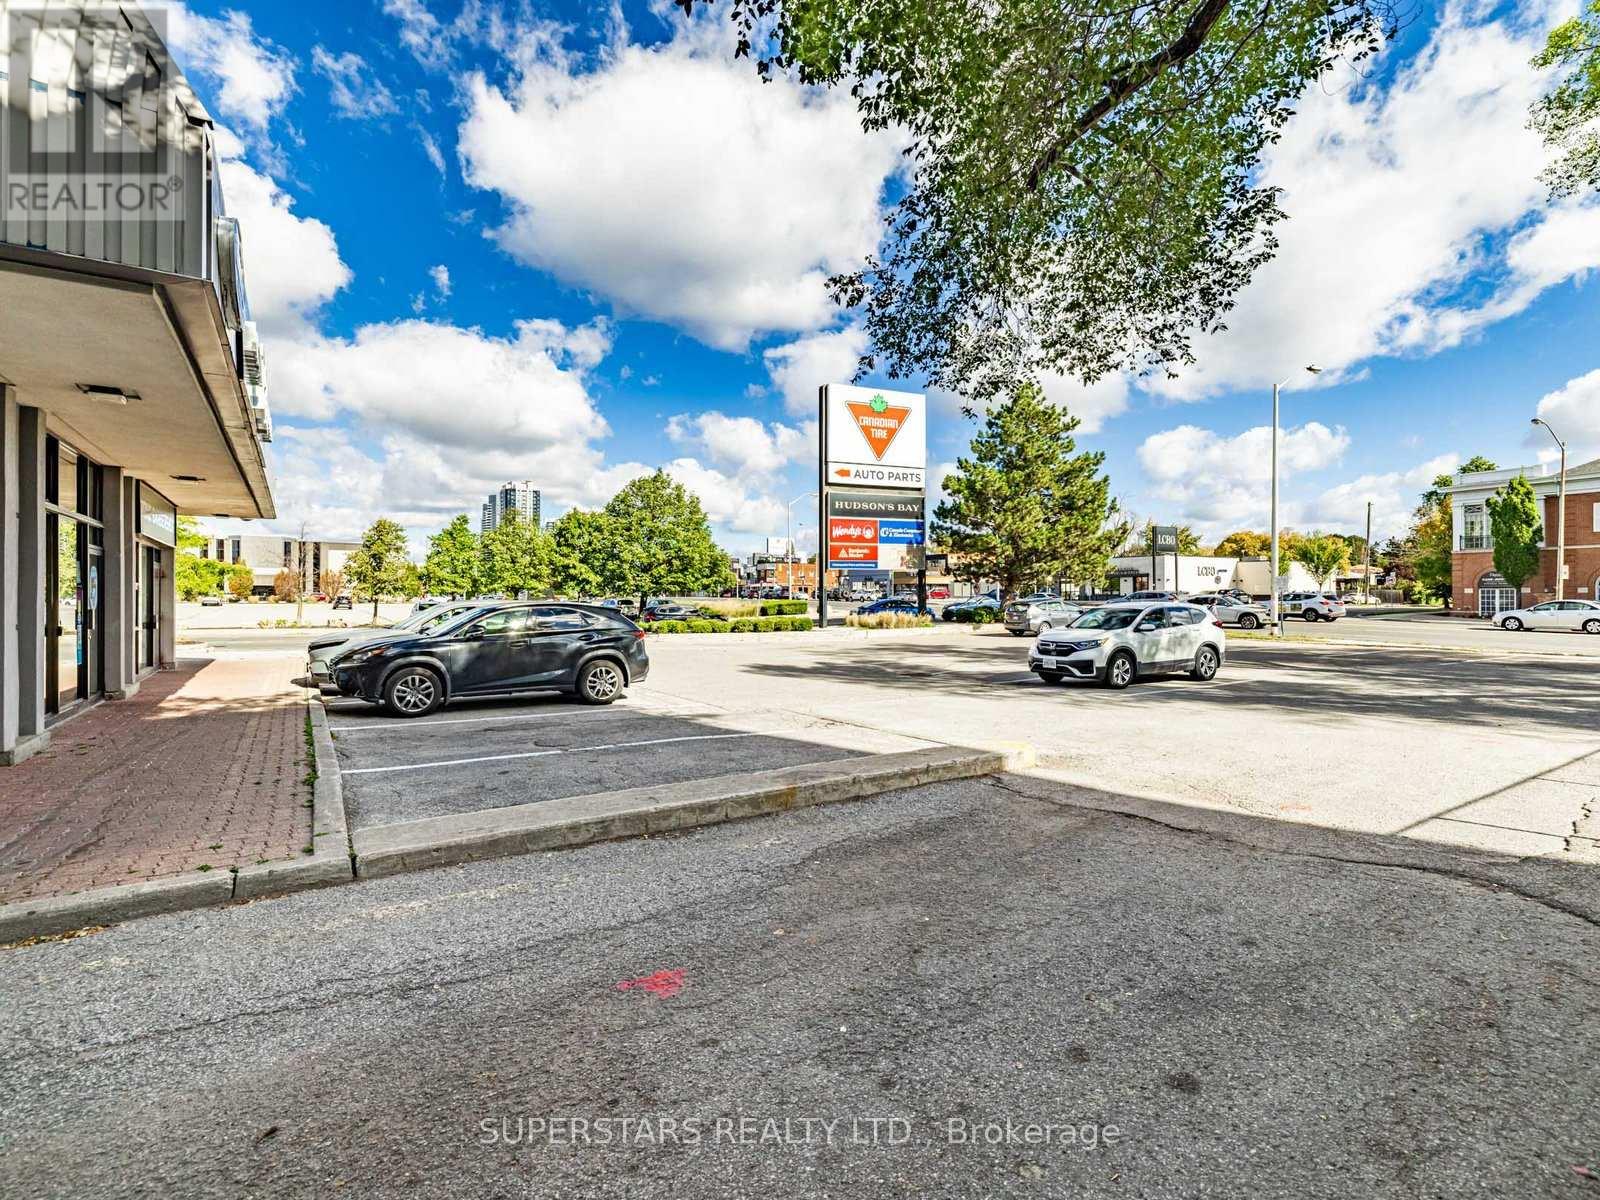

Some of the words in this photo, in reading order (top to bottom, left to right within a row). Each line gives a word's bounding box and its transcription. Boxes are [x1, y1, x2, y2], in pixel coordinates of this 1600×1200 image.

[859, 416, 899, 428] CANADIAN
[871, 428, 888, 439] TIRE
[854, 469, 885, 480] AUTO
[888, 471, 921, 482] PARTS
[835, 501, 895, 511] HUDSON'S
[897, 503, 919, 512] BAY
[1158, 534, 1176, 545] LCBO
[1197, 566, 1216, 576] LCBO
